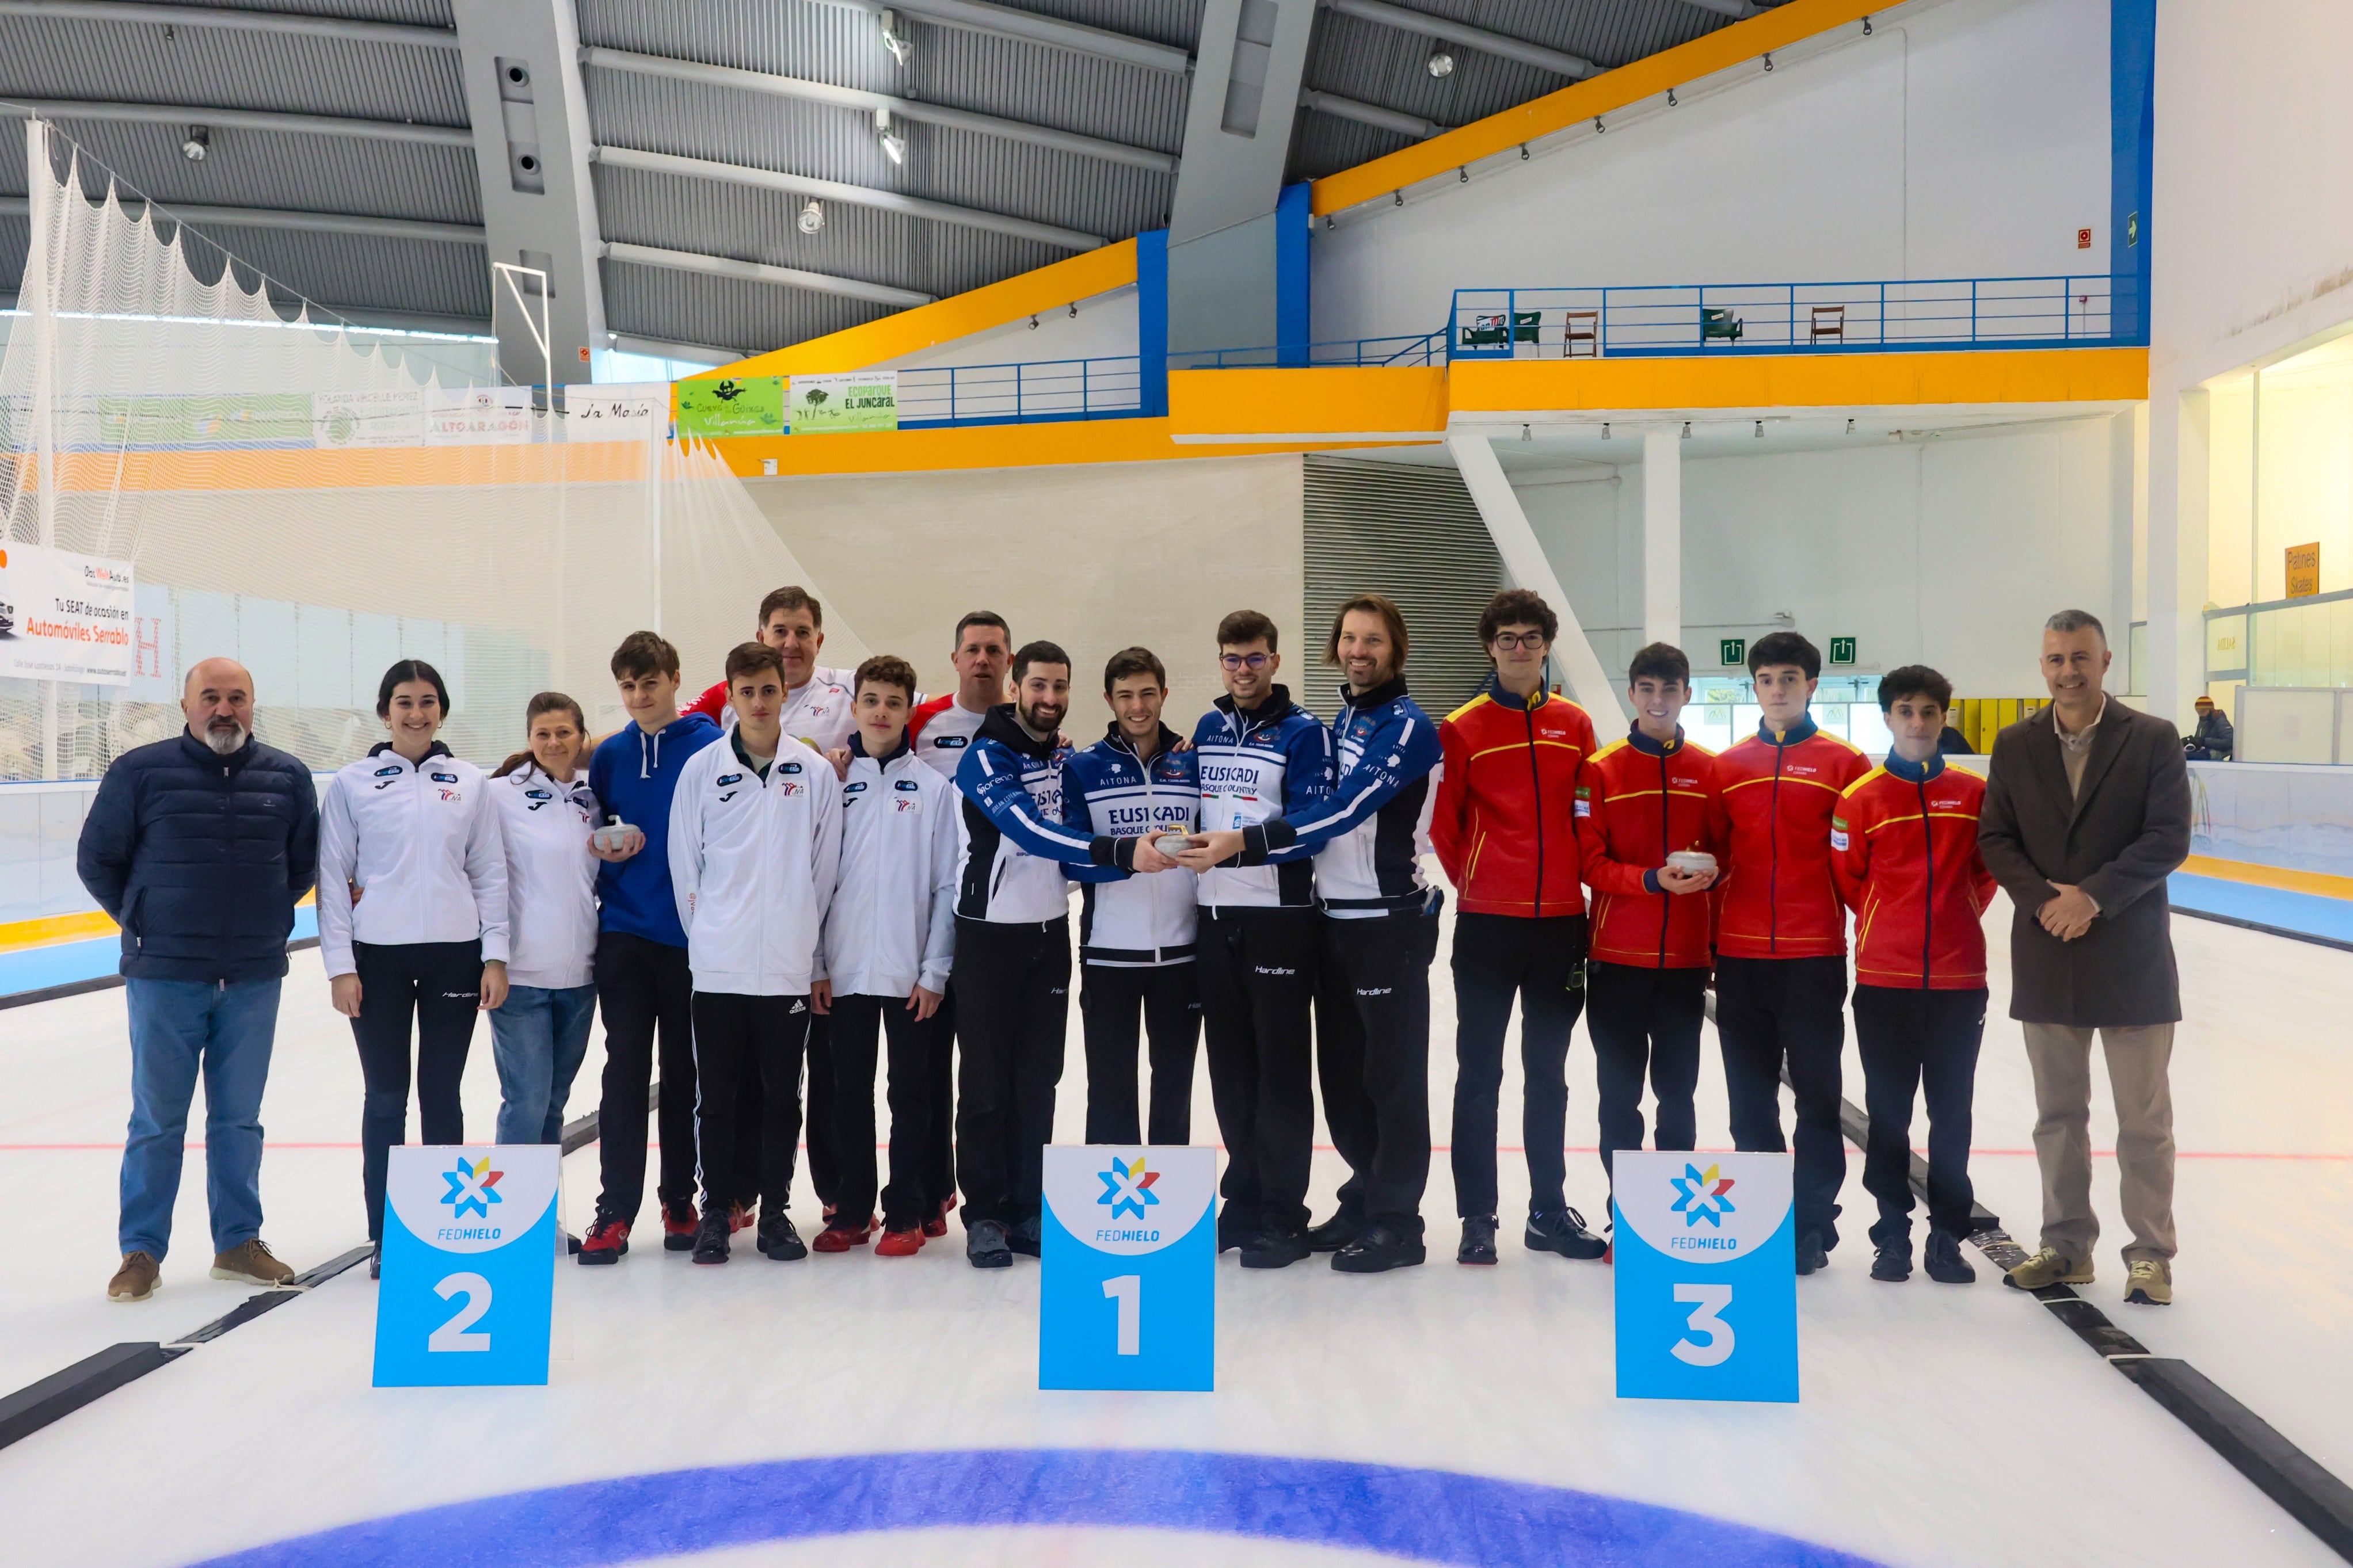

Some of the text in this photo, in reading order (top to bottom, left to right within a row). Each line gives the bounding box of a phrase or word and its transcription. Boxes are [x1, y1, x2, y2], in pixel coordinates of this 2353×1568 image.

[845, 399, 854, 409] EL
[2291, 576, 2313, 594] Skates
[55, 598, 64, 612] Tu
[66, 600, 83, 615] SEAT
[85, 604, 92, 616] de
[120, 611, 128, 620] en
[26, 617, 129, 646] Automóviles Serrablo
[1207, 735, 1233, 744] AITONA
[1100, 776, 1137, 786] AITONA
[1200, 766, 1259, 784] EUSKADI
[1363, 764, 1400, 788] AITONA
[1201, 784, 1224, 793] ASQUE
[1109, 807, 1189, 824] EUSKADI
[1110, 825, 1144, 835] BASQUE
[1255, 966, 1295, 975] Hardline
[1357, 987, 1392, 995] Hardline
[437, 1228, 501, 1240] FEDHIELO
[1096, 1230, 1160, 1242] FEDHIELO
[1672, 1237, 1737, 1250] FEDHIELO
[428, 1272, 493, 1352] 2
[1102, 1275, 1140, 1356] 1
[1670, 1283, 1735, 1367] 3
